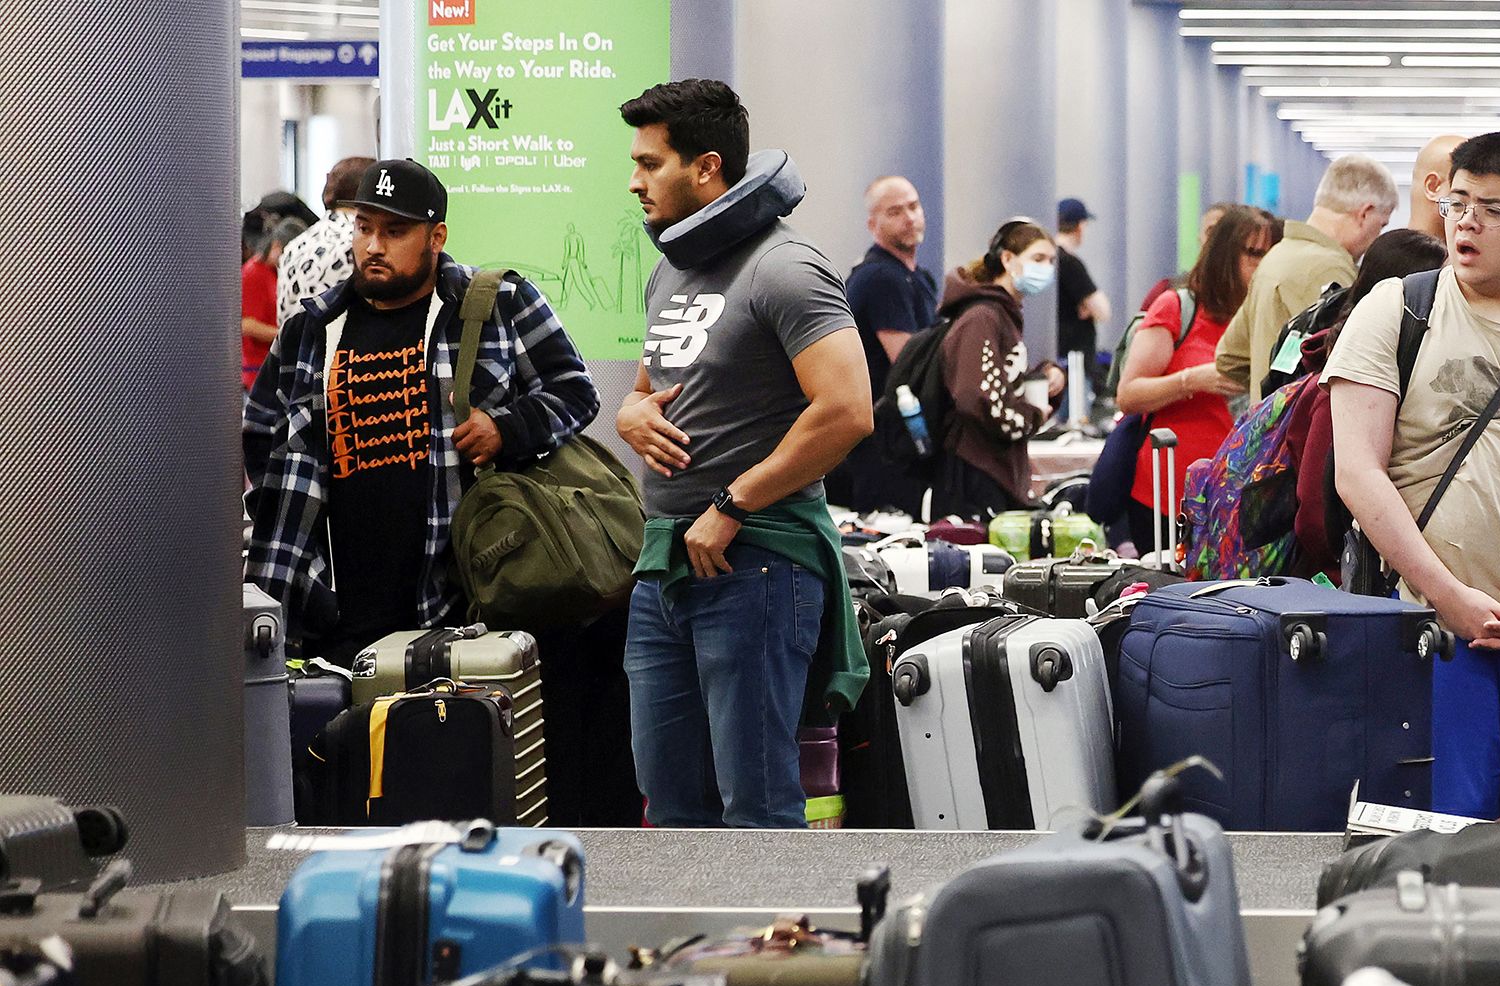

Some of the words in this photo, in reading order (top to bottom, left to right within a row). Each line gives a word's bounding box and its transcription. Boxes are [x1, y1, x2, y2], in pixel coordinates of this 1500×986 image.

[432, 0, 470, 19] New!
[427, 34, 455, 52] Get
[458, 33, 497, 51] Your
[501, 32, 553, 55] Steps
[559, 32, 577, 51] In
[583, 32, 613, 51] On
[428, 61, 450, 79] the
[455, 60, 492, 83] Way
[496, 63, 515, 78] to
[520, 59, 564, 78] Your
[569, 60, 617, 78] Ride.
[428, 136, 455, 152] Just
[457, 140, 465, 152] a
[468, 135, 509, 152] Short
[512, 135, 553, 152] Walk
[556, 139, 574, 152] to
[428, 155, 450, 168] TAXI
[553, 154, 587, 168] Uber
[375, 169, 395, 197] LA
[472, 184, 494, 193] Follow
[496, 184, 509, 193] the
[510, 184, 531, 195] Signs
[533, 184, 541, 193] to
